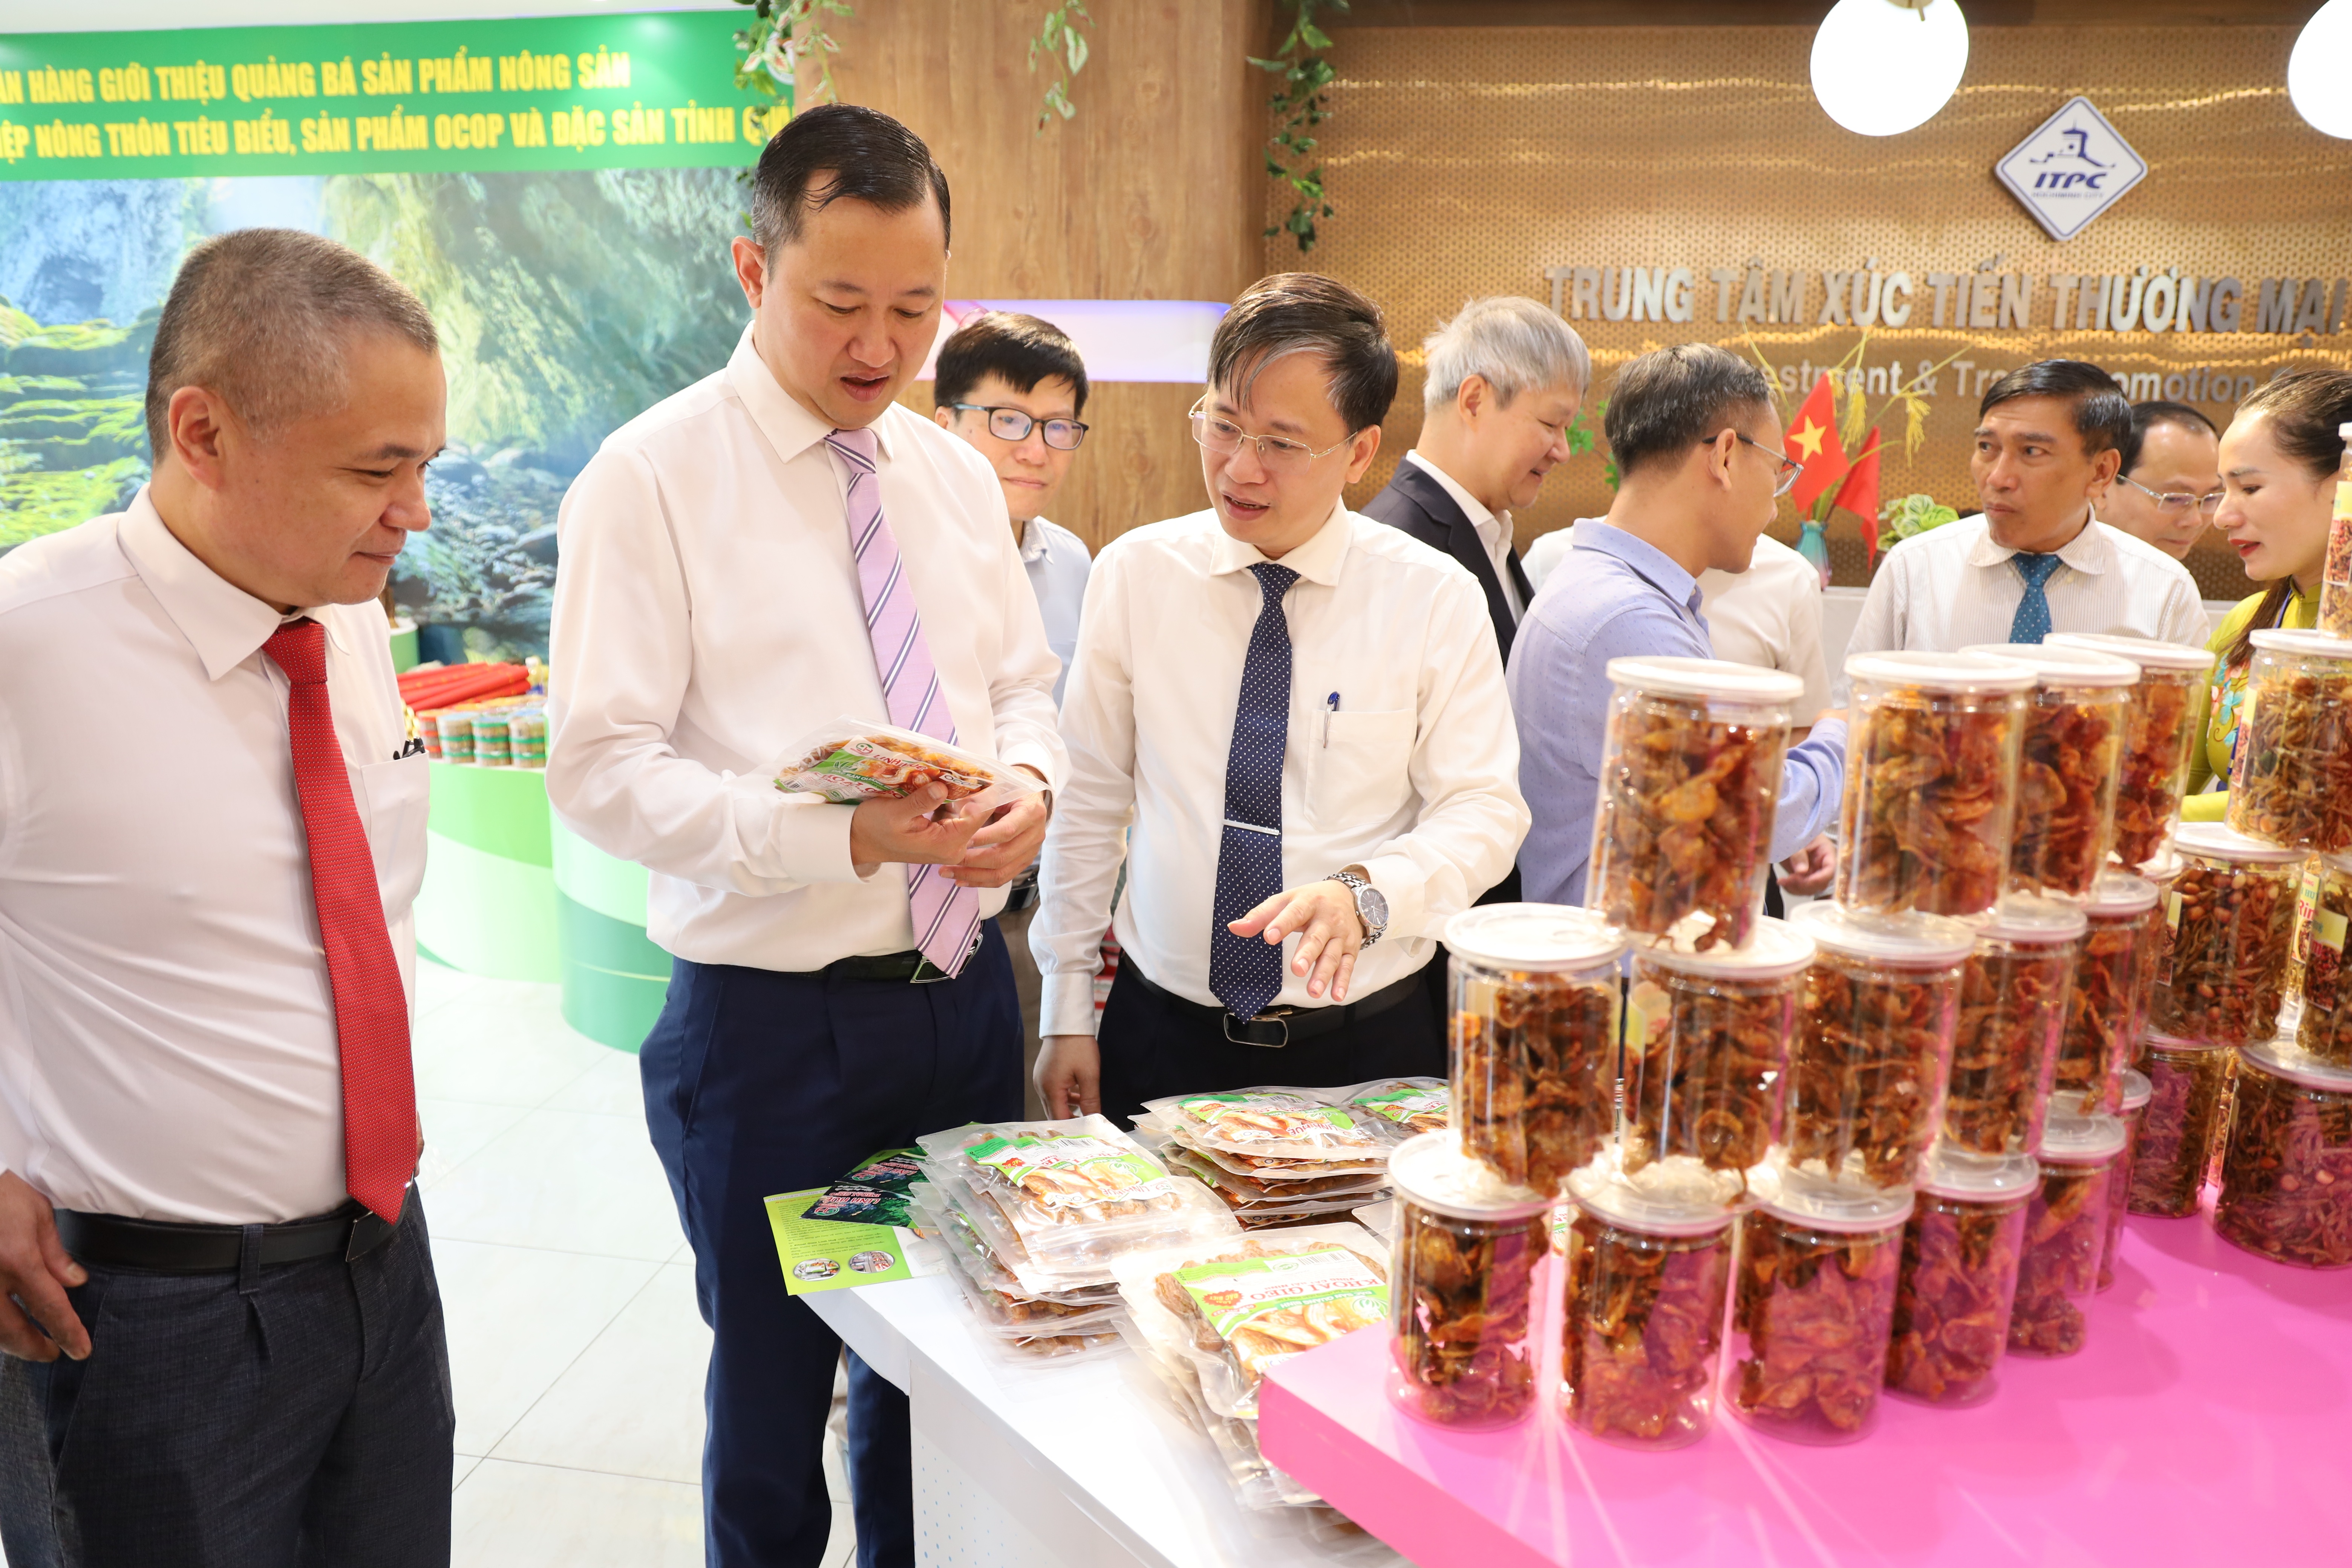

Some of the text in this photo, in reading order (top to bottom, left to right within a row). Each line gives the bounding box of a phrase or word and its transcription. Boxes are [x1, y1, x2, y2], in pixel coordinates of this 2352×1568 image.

[28, 64, 95, 103] HÀNG
[98, 61, 152, 102] GIỚI
[154, 59, 225, 106] THIỆU
[231, 55, 317, 102] QUẢNG
[321, 55, 358, 96] BÁ
[361, 51, 413, 96] SẢN
[418, 45, 493, 94] PHẨM
[499, 49, 572, 91] NÔNG
[577, 43, 631, 89] SẢN
[34, 118, 103, 158] NÔNG
[104, 116, 171, 157] THÔN
[173, 114, 229, 156] TIÊU
[233, 107, 297, 156] BIỂU,
[300, 109, 351, 153] SẢN
[355, 104, 429, 152] PHẨM
[434, 113, 505, 150] OCOP
[509, 106, 547, 148] VÀ
[551, 104, 606, 153] ĐẶC
[612, 100, 665, 146] SẢN
[671, 99, 736, 144] TỈNH
[2035, 172, 2108, 189] ITPC
[1544, 254, 2349, 349] TRUNG TÂM XÚC TIẾN THƯƠNG MẠI
[944, 775, 978, 789] OCOP
[1250, 1279, 1381, 1301] KHOAI GIEO
